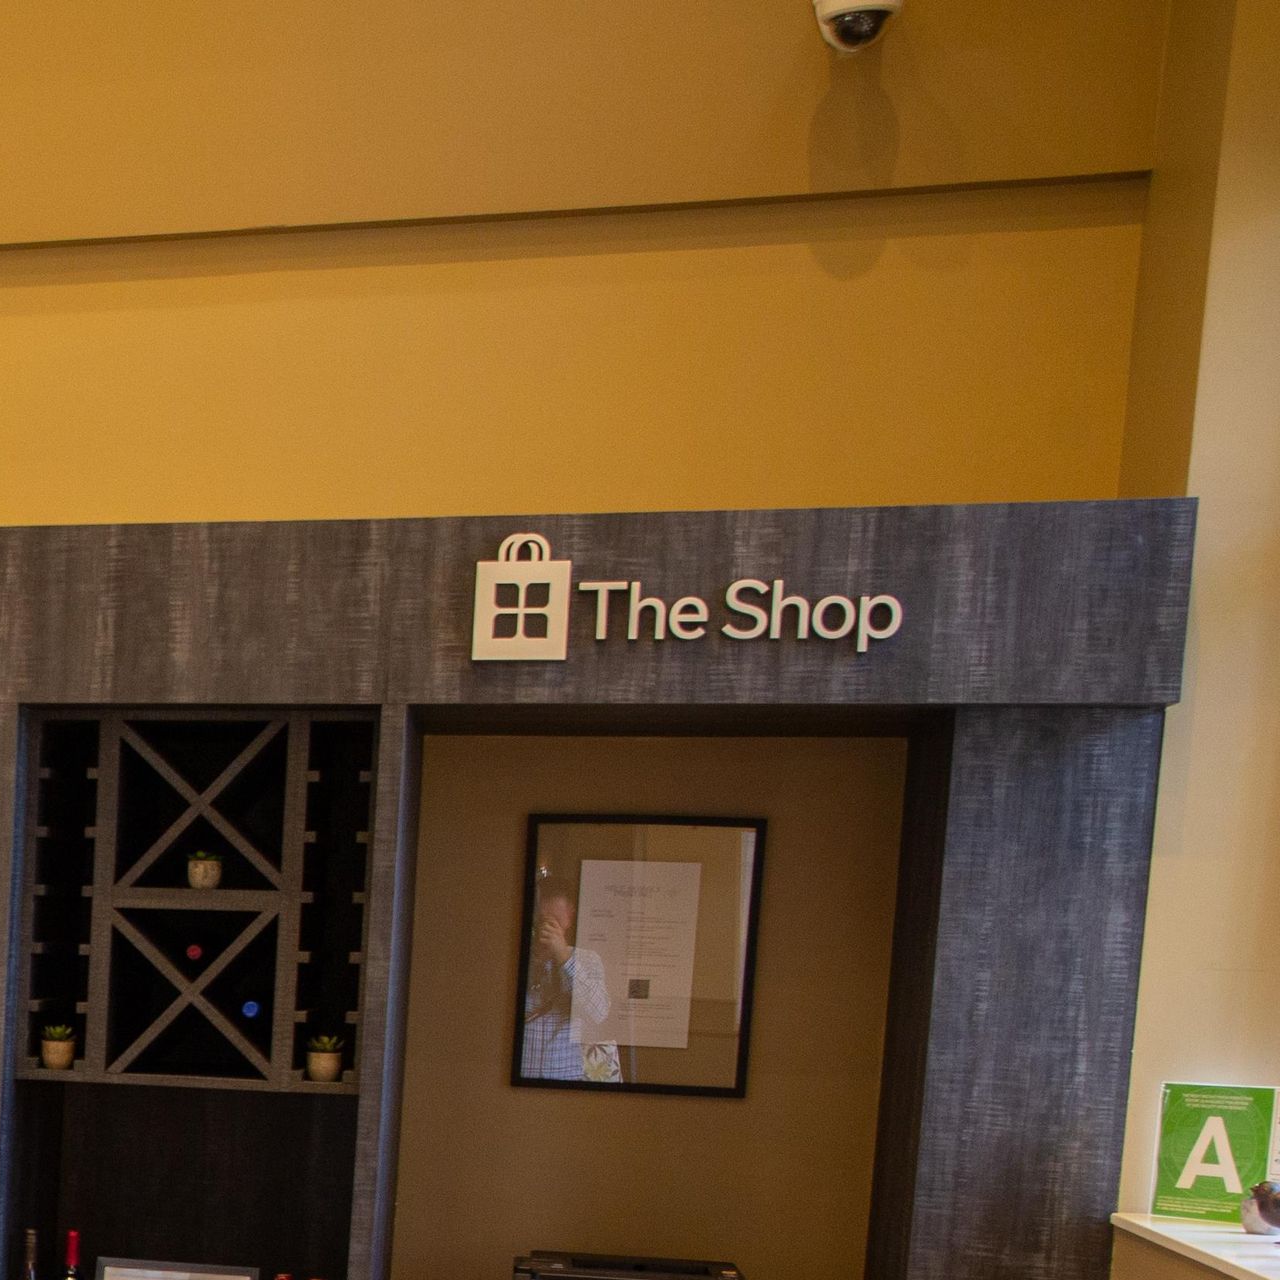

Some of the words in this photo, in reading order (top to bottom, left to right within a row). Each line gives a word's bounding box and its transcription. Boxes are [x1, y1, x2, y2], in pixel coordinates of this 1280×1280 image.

[578, 580, 709, 641] The
[721, 578, 904, 653] Shop
[1175, 1116, 1243, 1194] A
